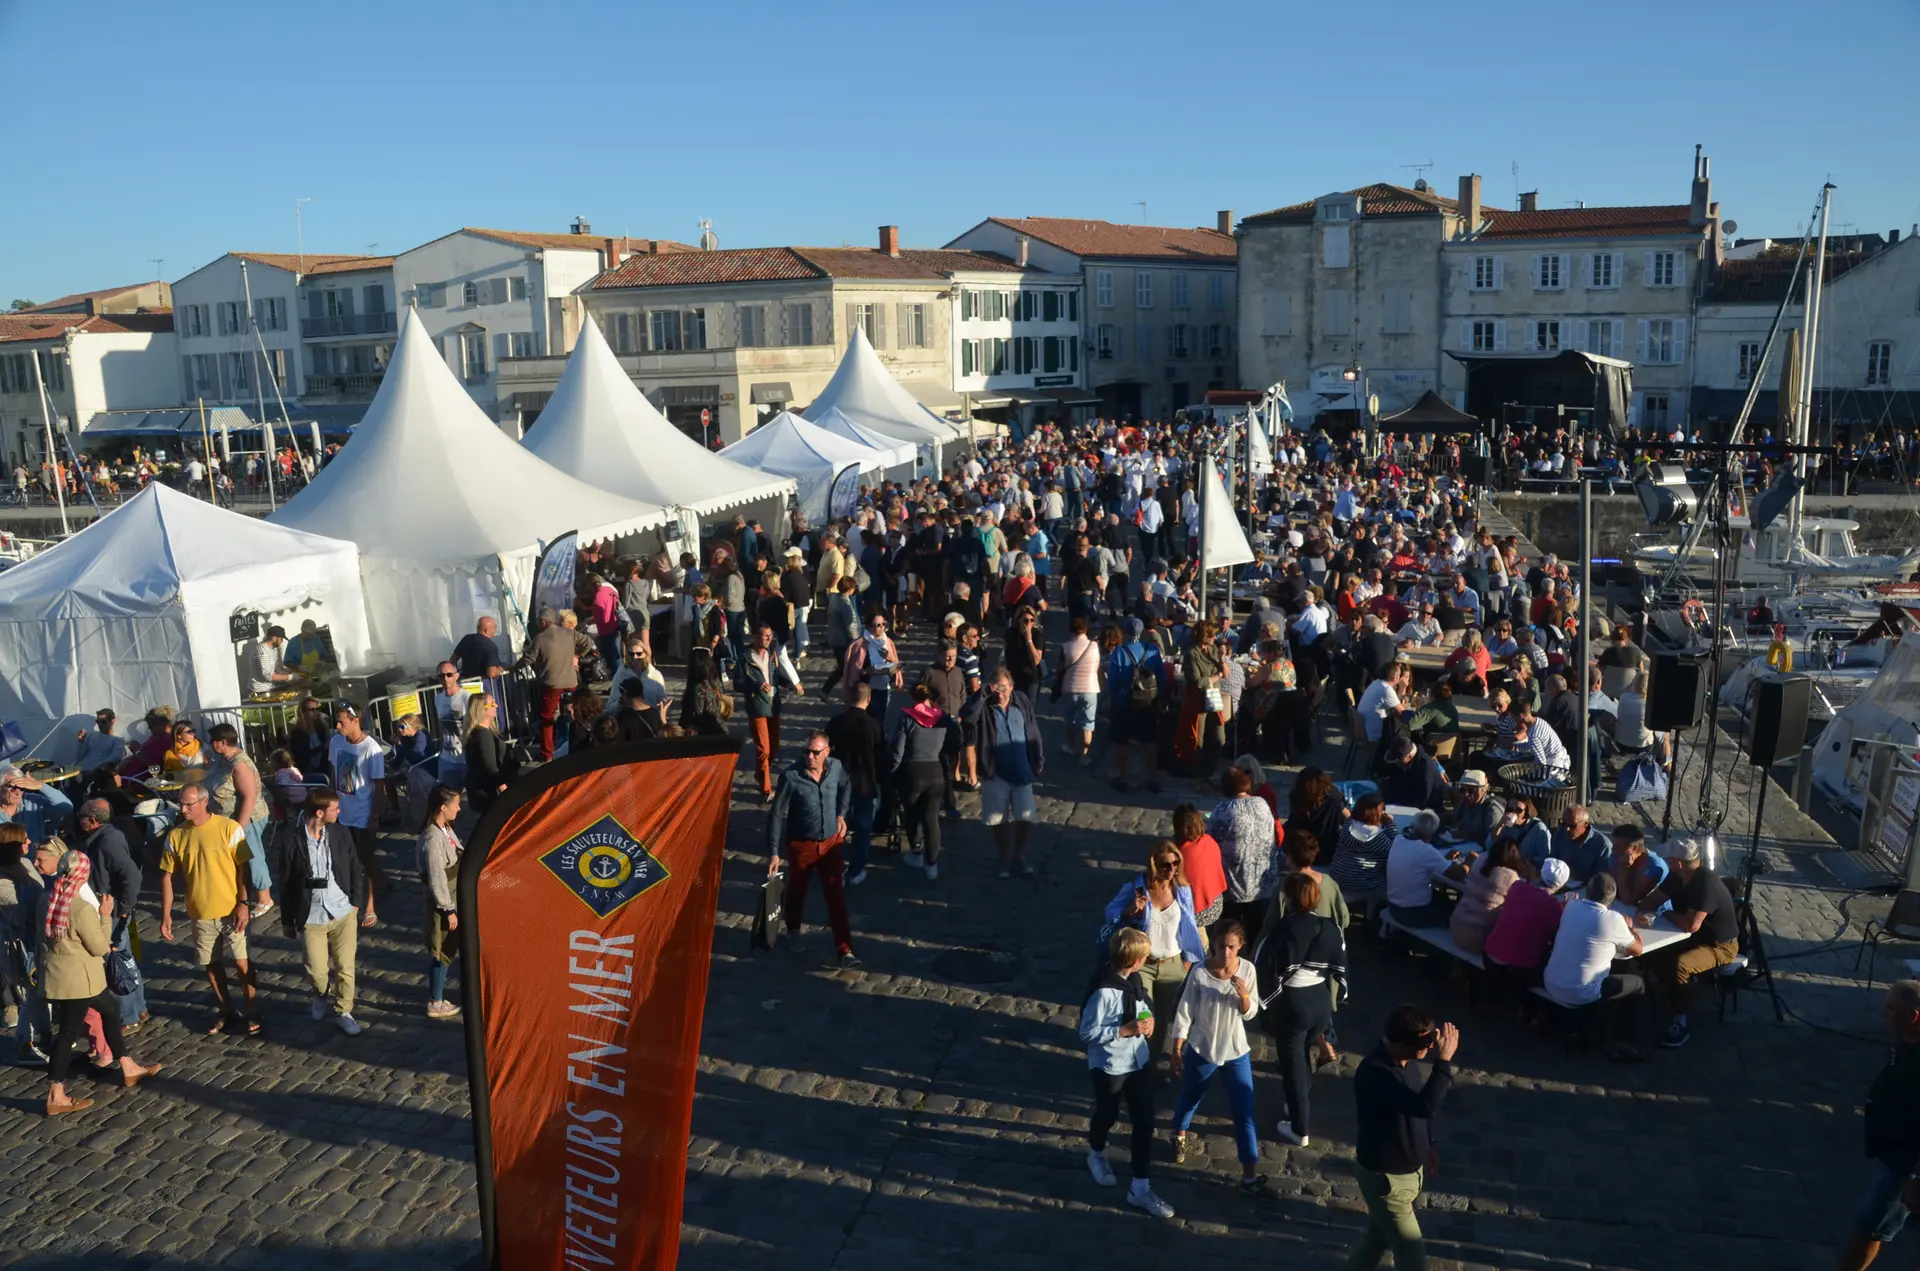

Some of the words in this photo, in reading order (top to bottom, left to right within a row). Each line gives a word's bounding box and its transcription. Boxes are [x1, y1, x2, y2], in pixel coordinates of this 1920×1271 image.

[561, 854, 575, 870] LES
[566, 833, 629, 854] SAUVETEURS
[568, 929, 635, 1027] MER
[567, 1033, 629, 1097] EN
